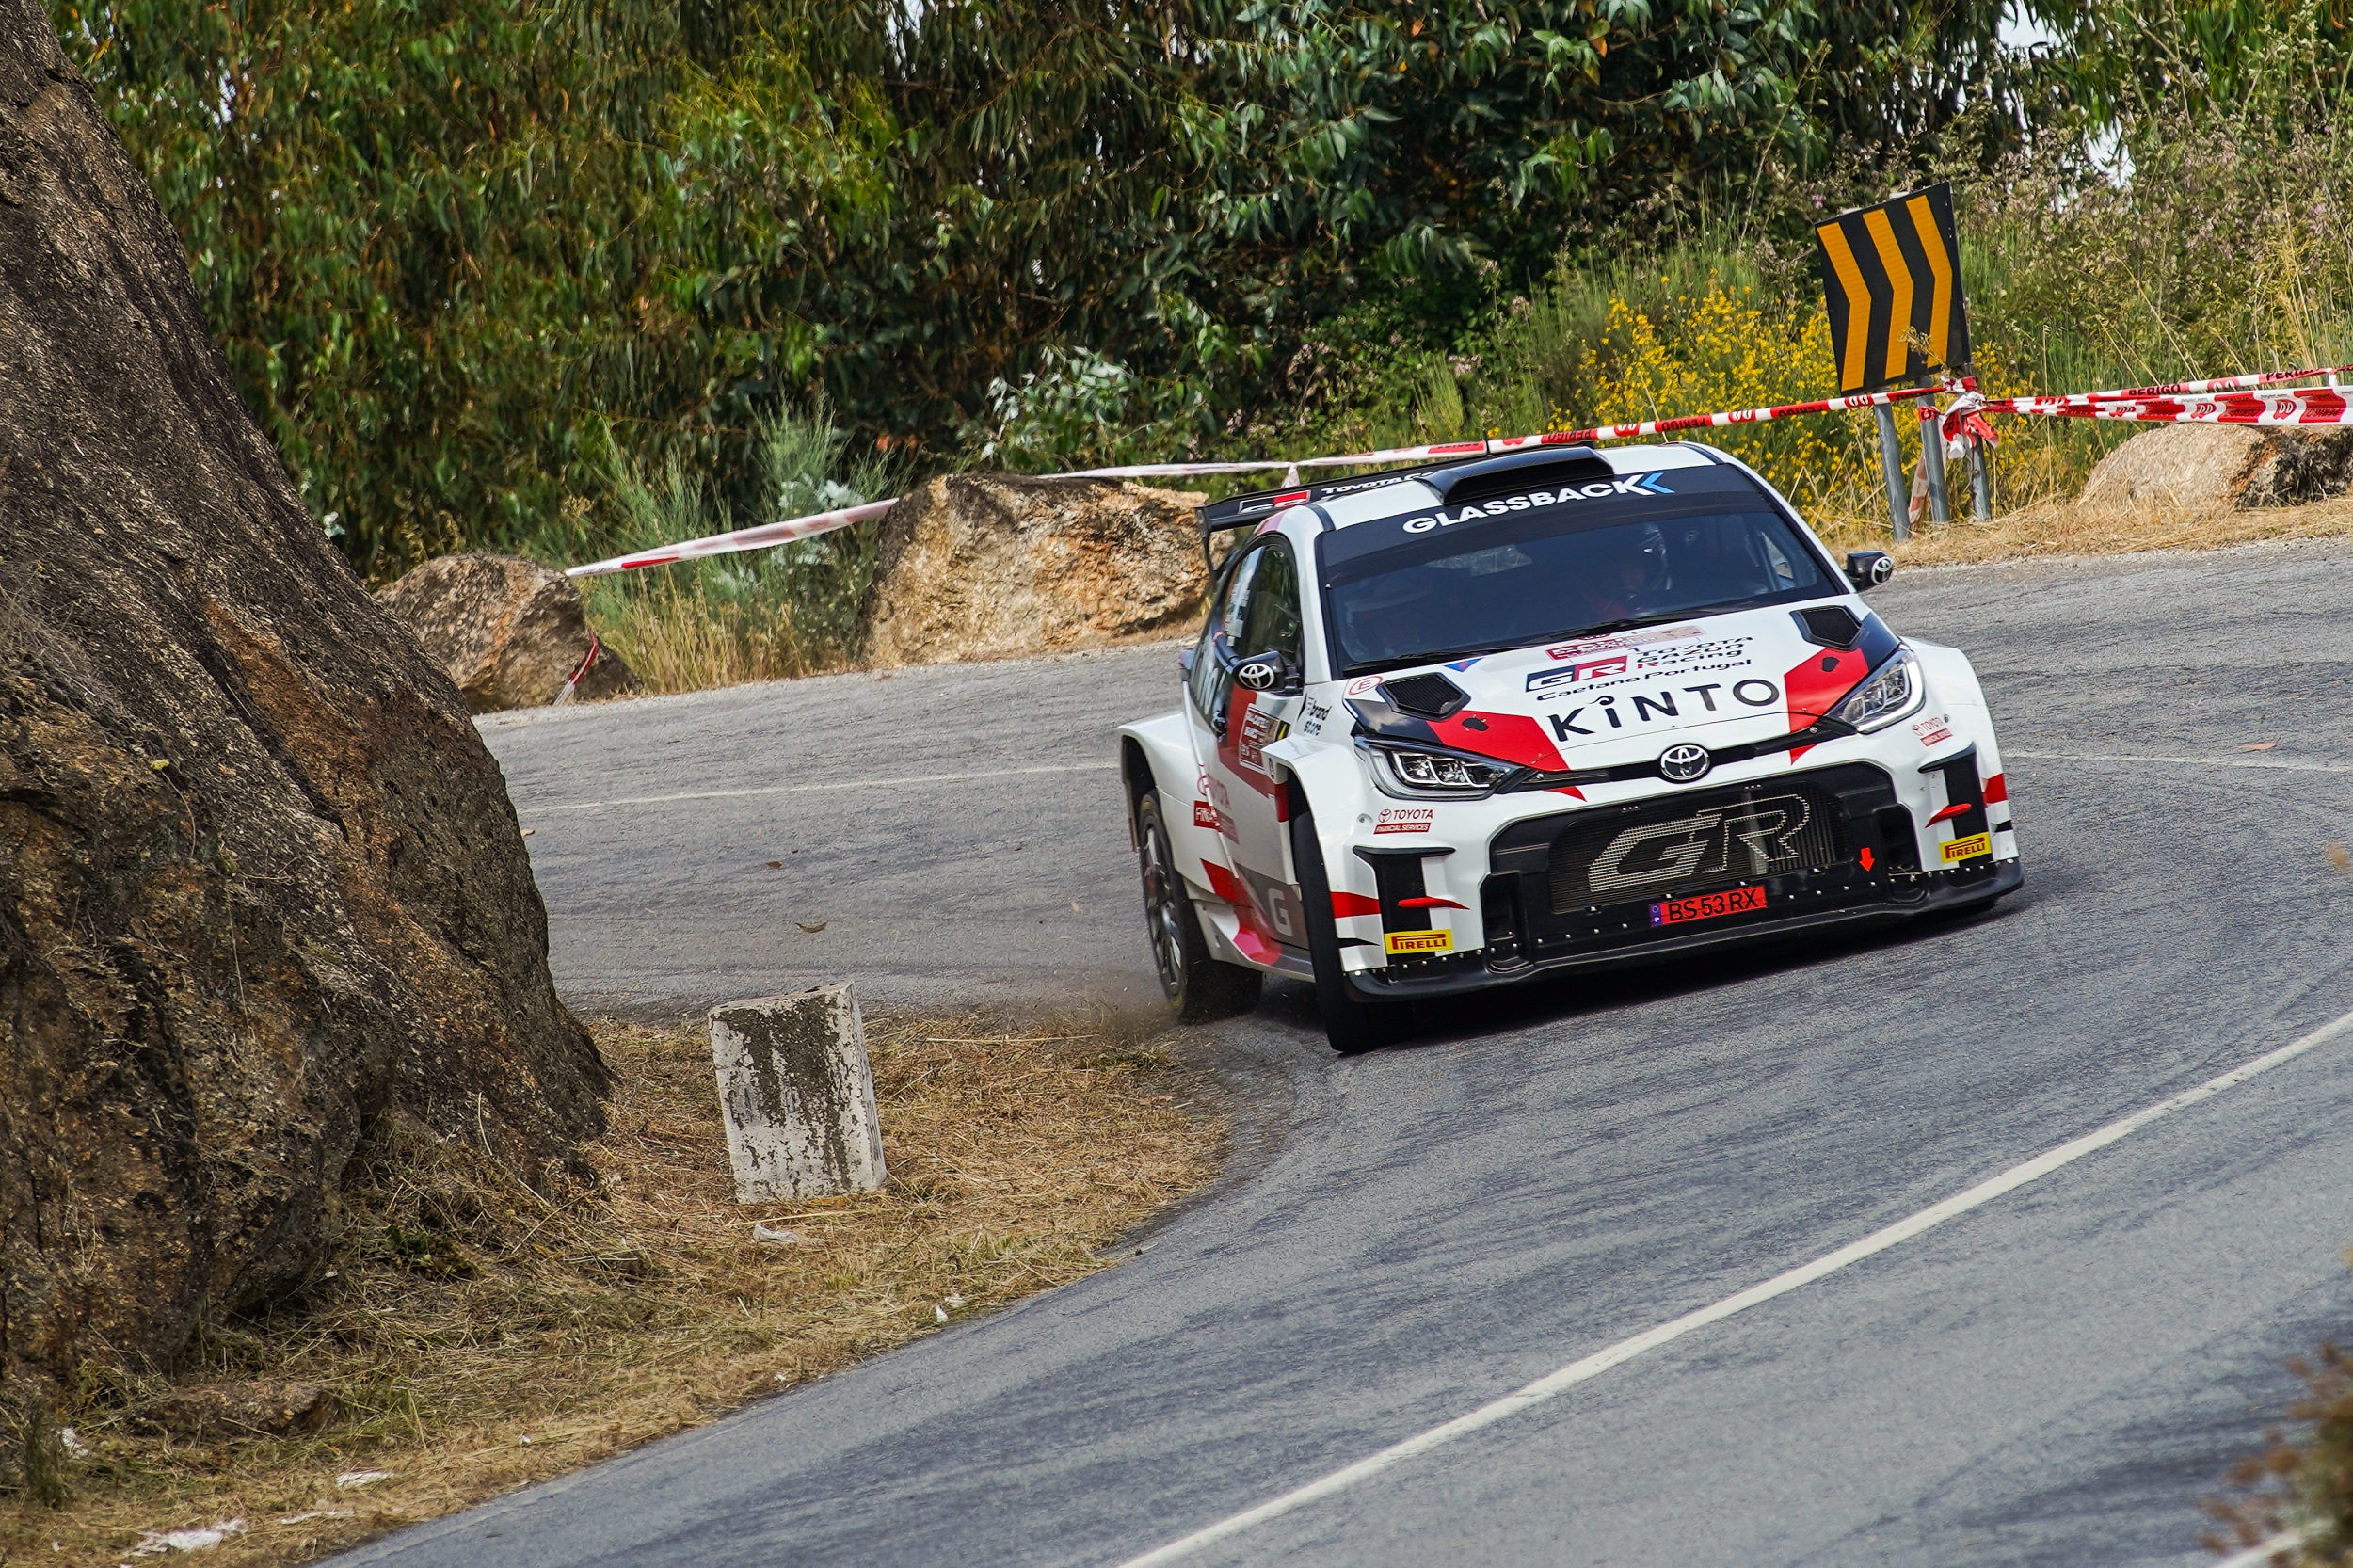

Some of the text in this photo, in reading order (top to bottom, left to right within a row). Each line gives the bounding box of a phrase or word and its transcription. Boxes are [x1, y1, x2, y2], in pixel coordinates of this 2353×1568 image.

[1402, 473, 1656, 534] GLASSBACK
[1637, 636, 1753, 657] TOYOTA
[1637, 643, 1744, 663] GAZOO
[1638, 649, 1742, 669] Racing
[1528, 662, 1625, 691] GR
[1536, 659, 1752, 701] Caetano Portugal
[1394, 808, 1433, 821] TOYOTA
[1587, 793, 1811, 893] GR
[1945, 837, 1986, 859] PIRELLI
[1668, 900, 1698, 921] BS
[1700, 895, 1725, 917] 53
[1728, 888, 1759, 912] RX
[1391, 933, 1447, 950] PIRELLI
